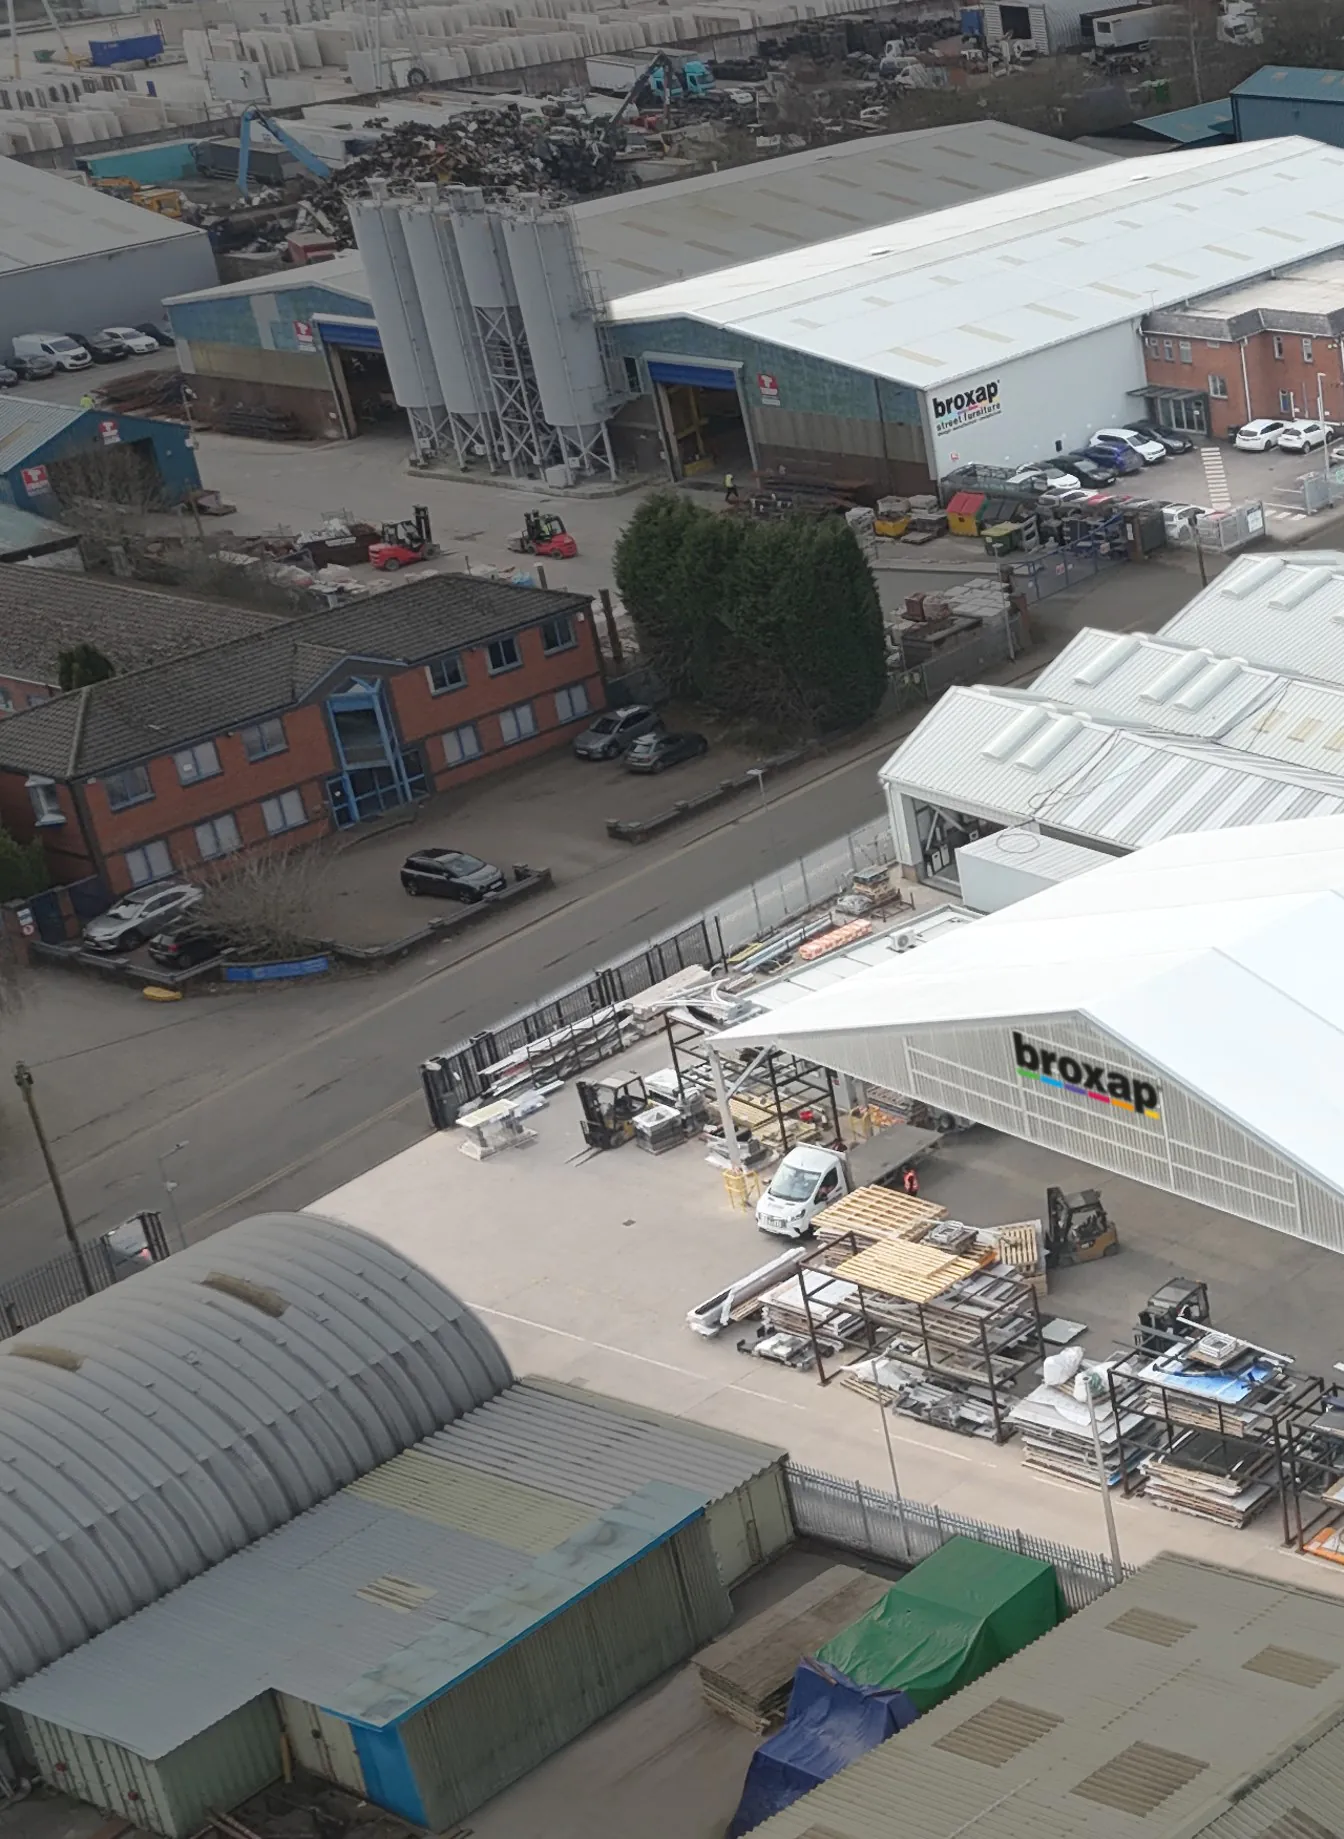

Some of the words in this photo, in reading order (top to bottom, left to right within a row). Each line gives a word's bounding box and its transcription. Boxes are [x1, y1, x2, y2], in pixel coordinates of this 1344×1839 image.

[932, 380, 999, 418] broxap
[936, 415, 962, 432] street
[963, 402, 1001, 421] furniture
[1012, 1030, 1158, 1114] broxap
